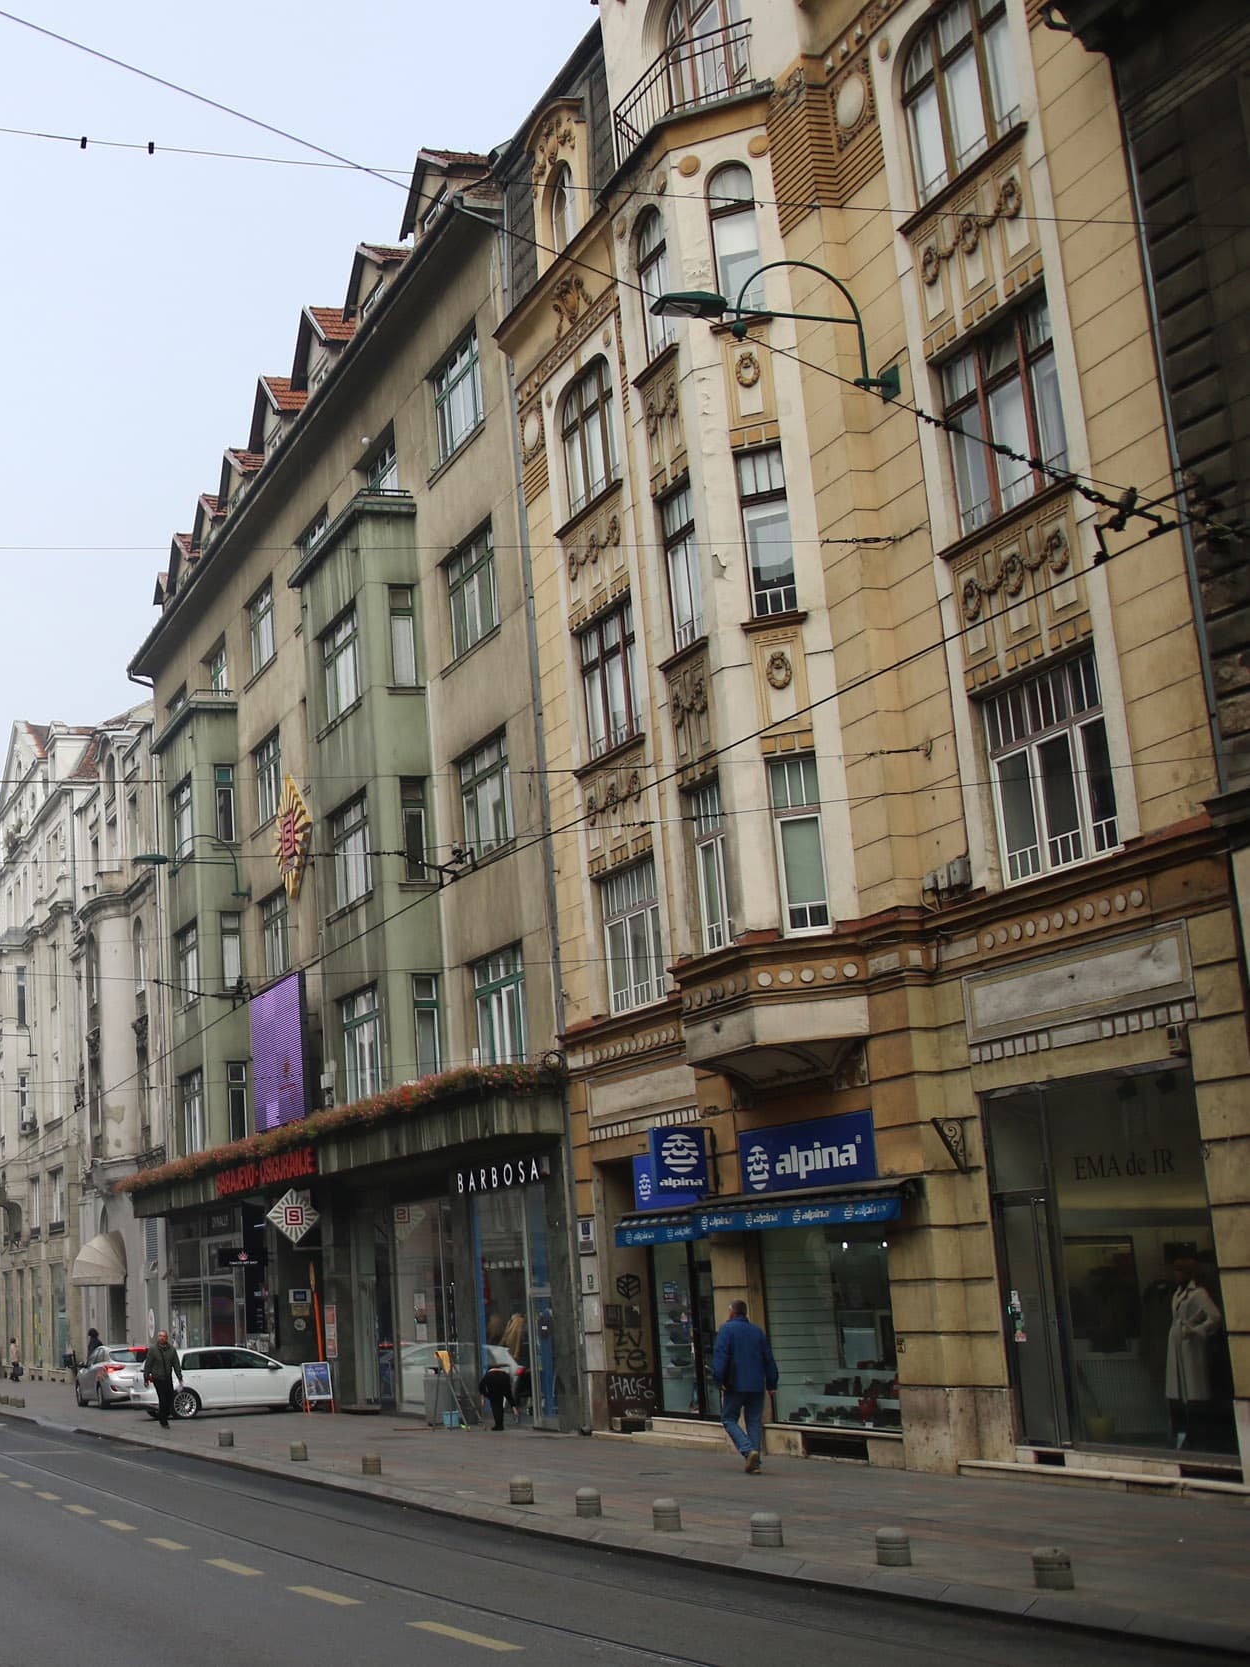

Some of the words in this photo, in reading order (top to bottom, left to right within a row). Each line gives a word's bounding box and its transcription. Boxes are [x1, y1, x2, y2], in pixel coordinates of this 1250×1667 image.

[775, 1142, 857, 1179] alpina
[1074, 1152, 1121, 1180] EMA
[1126, 1149, 1147, 1176] de
[457, 1158, 539, 1193] BARBOSA
[660, 1177, 703, 1188] alpina
[753, 1211, 779, 1224] alpina
[802, 1208, 831, 1221] alpina
